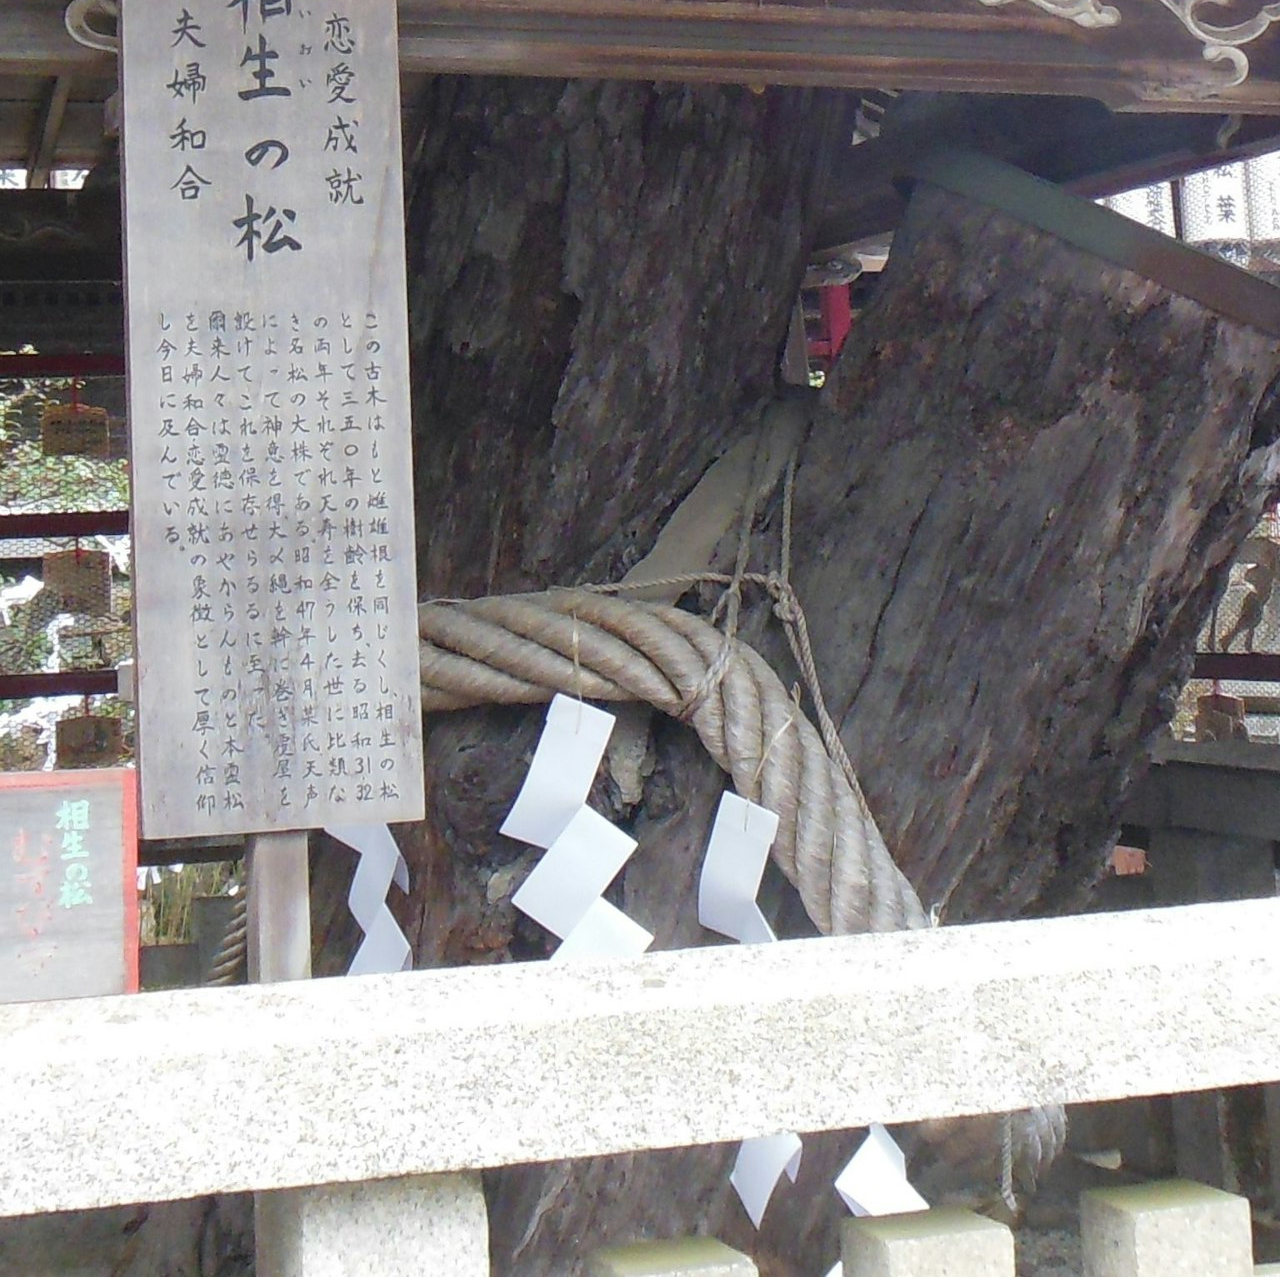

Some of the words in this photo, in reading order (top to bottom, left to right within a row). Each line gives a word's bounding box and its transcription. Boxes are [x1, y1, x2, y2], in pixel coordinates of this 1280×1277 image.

[166, 8, 212, 201] 夫婦和合
[322, 12, 364, 206] 恋愛成就
[55, 798, 94, 910] 相生の松
